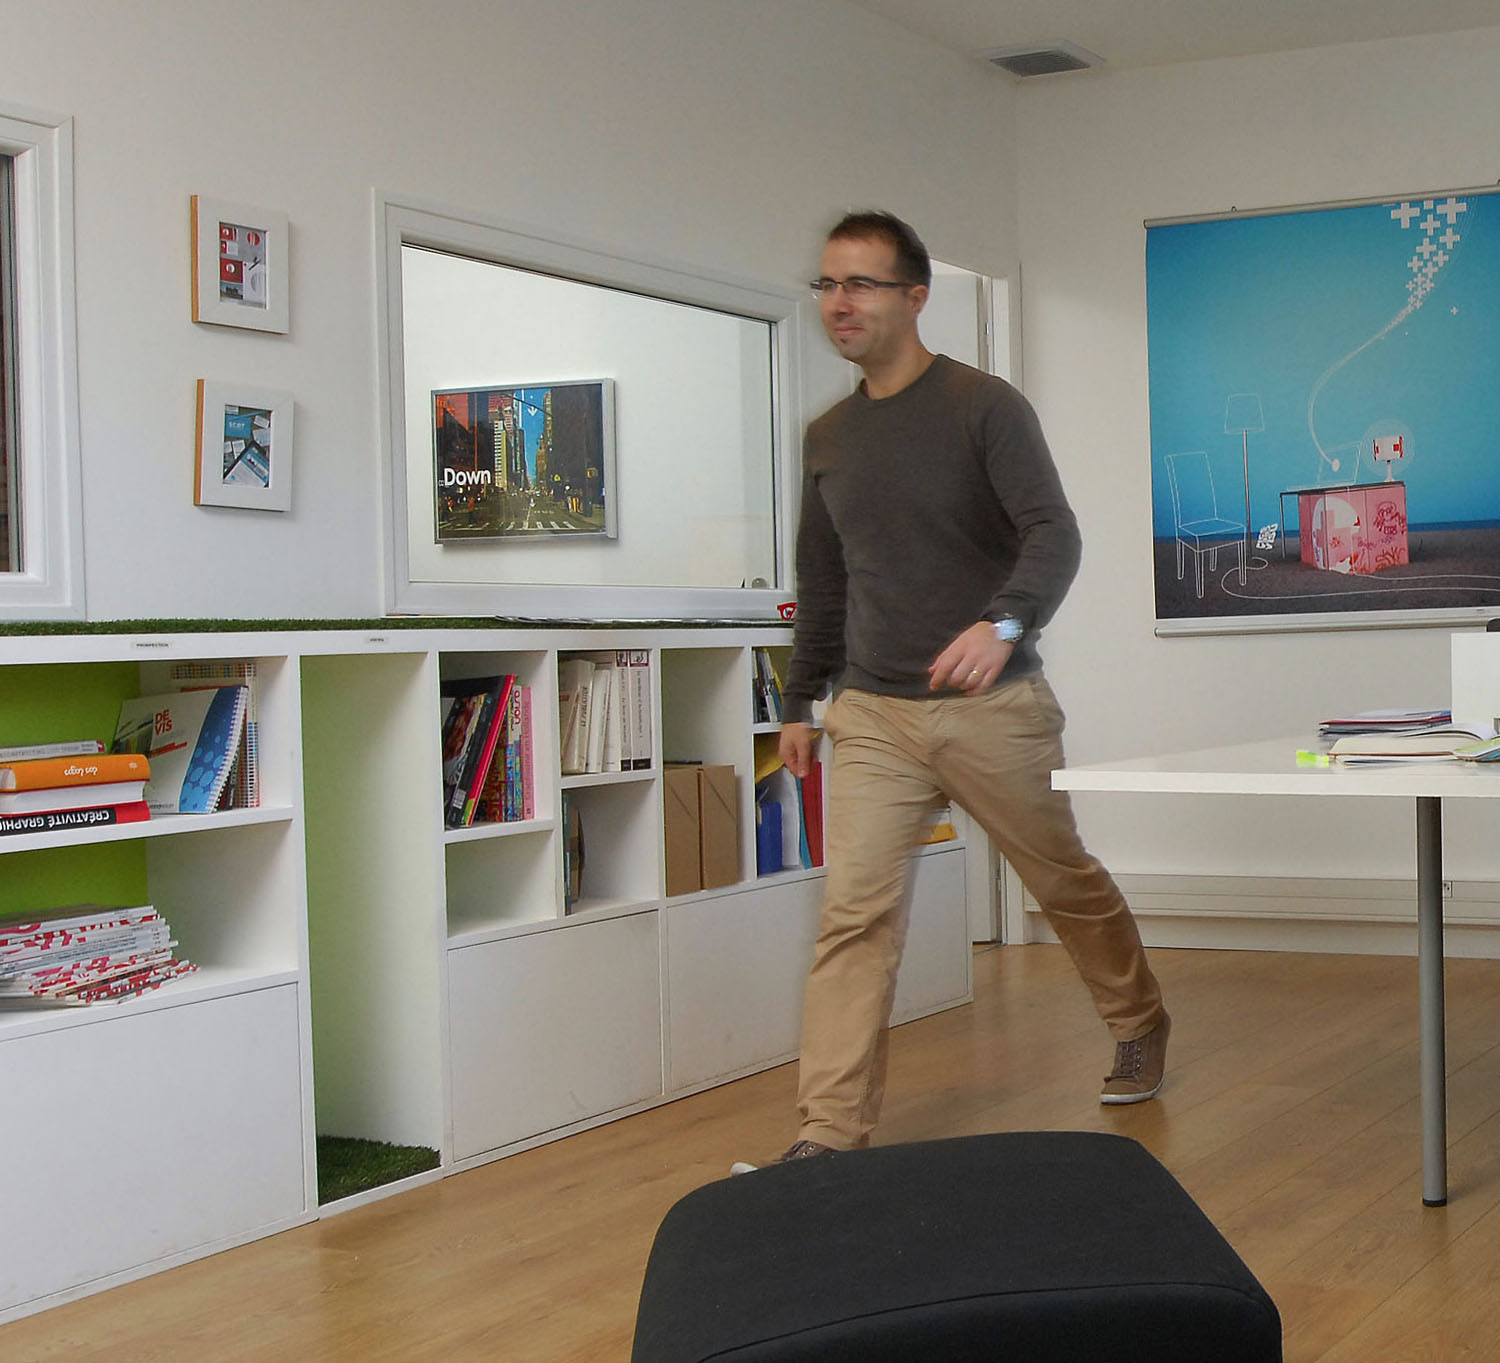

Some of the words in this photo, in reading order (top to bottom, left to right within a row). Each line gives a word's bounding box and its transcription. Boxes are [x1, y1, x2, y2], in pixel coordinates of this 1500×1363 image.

[444, 468, 491, 486] Down
[155, 709, 170, 724] DE
[155, 719, 173, 736] VIS
[0, 817, 44, 832] GRAPHI
[48, 810, 110, 828] CRÉATIVITÉ
